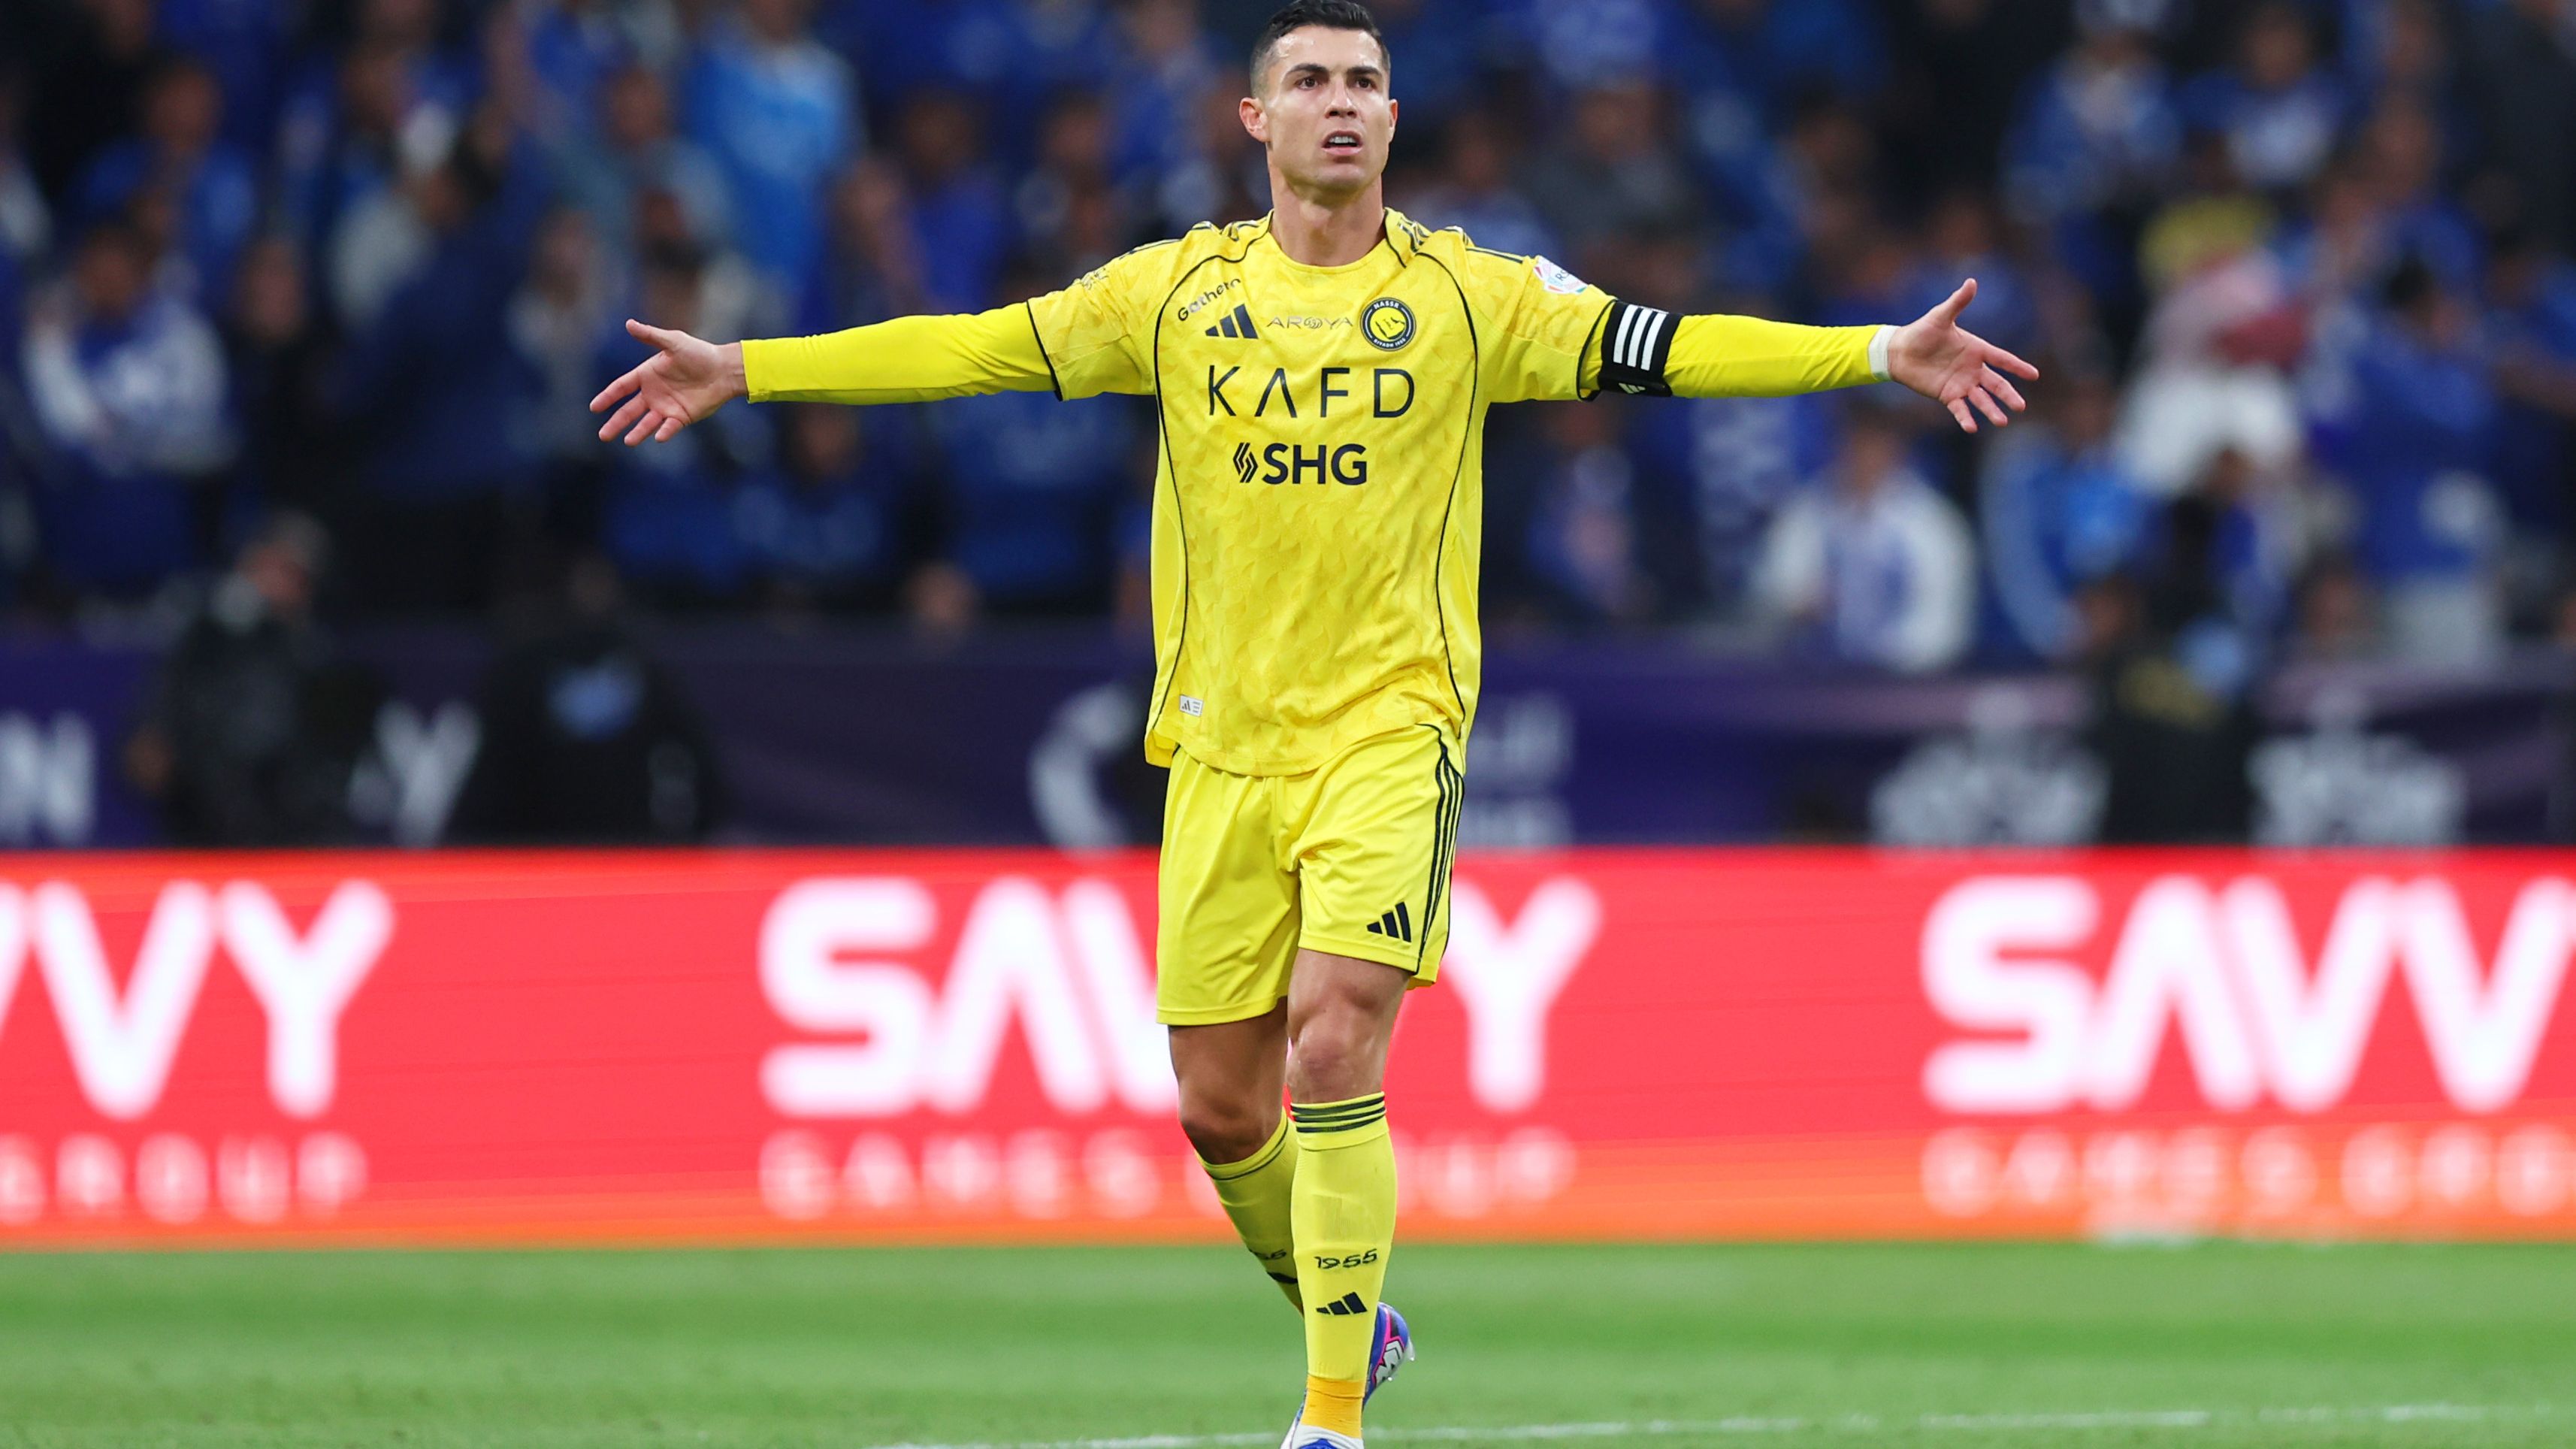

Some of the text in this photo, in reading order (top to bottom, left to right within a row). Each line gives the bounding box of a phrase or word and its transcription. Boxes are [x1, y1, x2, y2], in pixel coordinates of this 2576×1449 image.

[1374, 301, 1400, 309] NASSR
[1208, 365, 1415, 418] KAFD
[1262, 443, 1368, 486] SHG
[0, 878, 397, 1120] VY
[756, 875, 1602, 1118] SAVY
